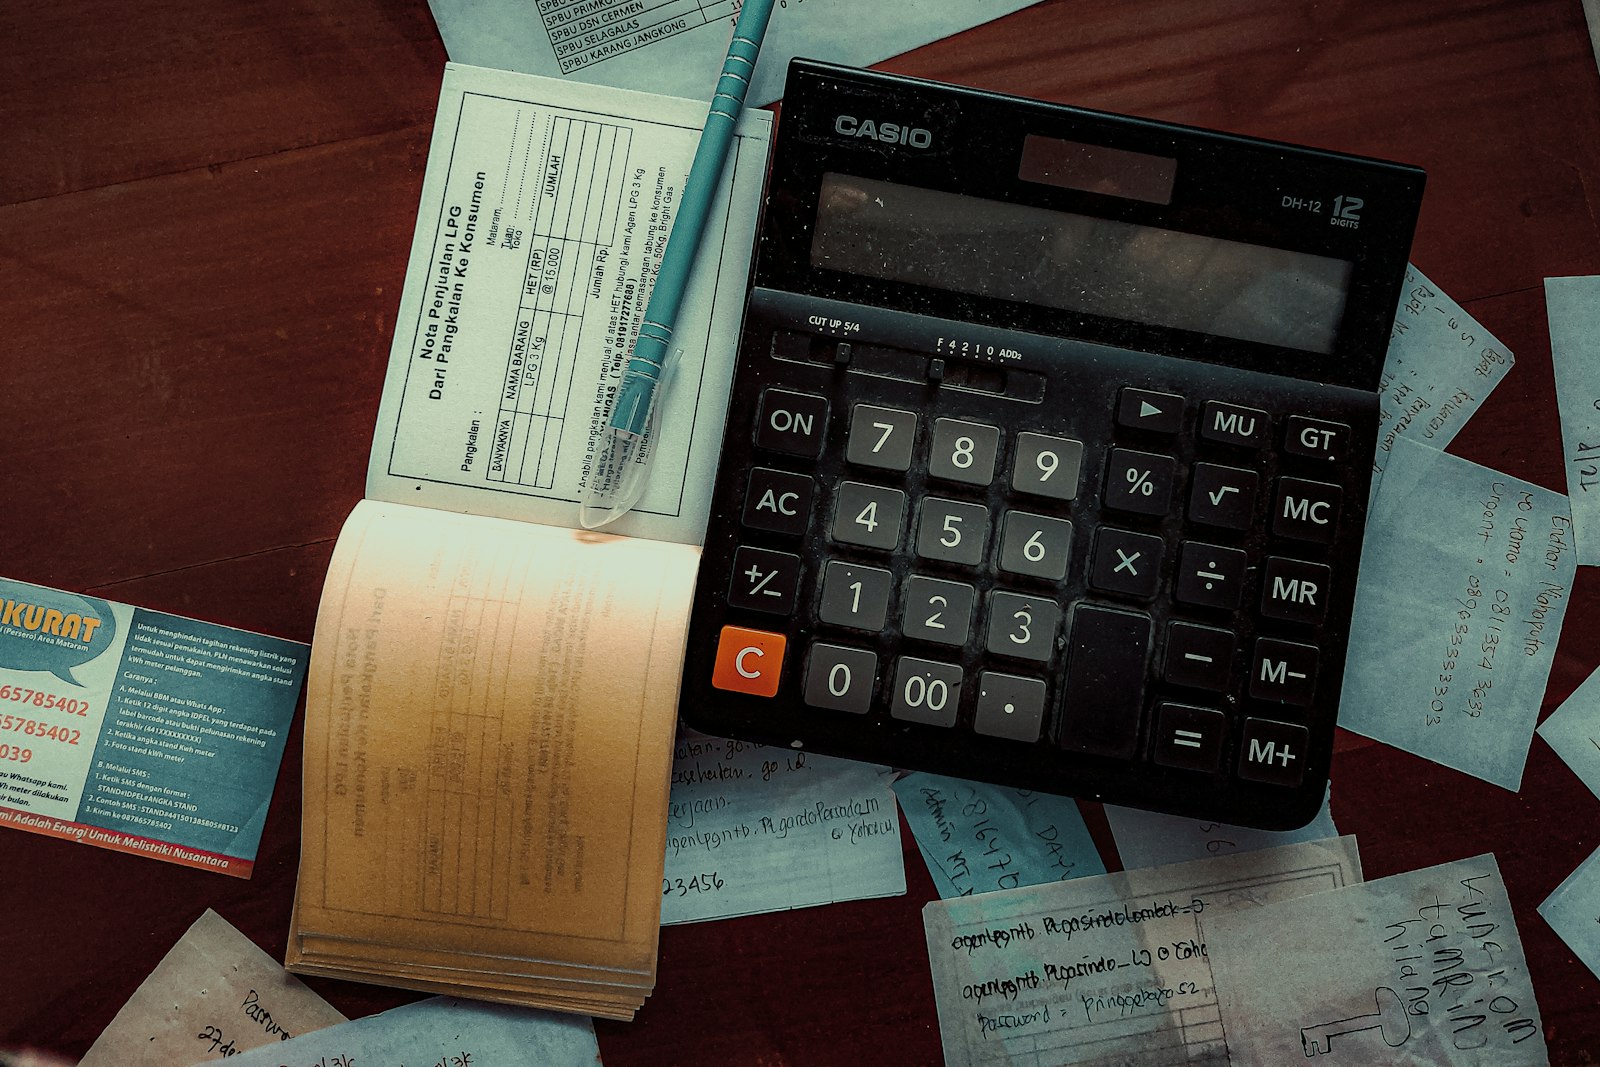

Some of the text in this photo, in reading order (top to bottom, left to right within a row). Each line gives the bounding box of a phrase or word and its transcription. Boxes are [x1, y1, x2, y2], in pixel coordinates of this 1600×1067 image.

[546, 12, 572, 26] SPBU
[551, 2, 644, 41] SPBU DSN CERMEN
[557, 20, 640, 56] SPBU SELAGALAS
[563, 19, 686, 71] SPBU KARANG JANGKONG
[835, 115, 932, 149] CASIO
[633, 168, 645, 180] Kg
[650, 166, 665, 210] konsumen
[628, 190, 639, 208] LPG
[663, 186, 673, 203] Gas
[1281, 195, 1322, 213] DH-12
[1333, 195, 1364, 220] 12
[624, 211, 635, 233] Agen
[648, 212, 657, 222] ke
[658, 205, 670, 231] Bright
[1330, 217, 1359, 229] DIGITS
[509, 229, 522, 249] Toko
[619, 235, 631, 255] kami
[643, 225, 657, 253] tabung
[420, 206, 461, 358] Nota Penjualan LPG
[428, 172, 484, 399] Dari Pangkalan Ke Konsumen
[590, 247, 609, 298] Jumlah Rp.
[614, 257, 629, 292] hubungi
[635, 256, 650, 311] pemasangan
[492, 155, 560, 471] BANYAKNYA NAMA BARANG HET (RP) JUMLAH
[524, 363, 537, 386] LPG
[531, 336, 545, 350] Kg
[544, 247, 559, 280] 15.000
[610, 293, 620, 313] HET
[615, 284, 634, 347] 081917277688
[607, 315, 617, 334] atas
[630, 313, 640, 336] antar
[808, 316, 860, 333] CUT UP 5/4
[604, 336, 613, 344] di
[937, 337, 944, 347] F
[949, 339, 957, 349] 4
[962, 341, 969, 351] 2
[975, 344, 980, 353] 1
[987, 346, 994, 356] 0
[599, 346, 611, 380] menjual
[610, 351, 623, 371] Telp.
[593, 382, 605, 403] kami
[587, 406, 600, 452] pangkalan
[1214, 411, 1335, 451] MU GT
[460, 420, 479, 471] Pangkalan
[770, 409, 813, 436] ON
[872, 422, 894, 453] 7
[951, 437, 975, 468] 8
[1036, 450, 1059, 482] 9
[1283, 496, 1330, 525] MC
[755, 489, 1046, 562] AC 4 5 6
[1272, 576, 1317, 605] MR
[0, 598, 101, 643] KURAT
[850, 581, 862, 613] 1
[925, 595, 947, 629] 2
[1009, 611, 1032, 644] 3
[38, 634, 55, 645] Area
[55, 640, 89, 652] Mataram
[735, 646, 948, 711] C 0 00
[0, 714, 80, 745] 5785402
[1249, 738, 1295, 767] M+
[12, 813, 51, 829] Adalah
[52, 821, 88, 838] Energi
[88, 829, 121, 844] Untuk
[122, 837, 172, 854] Melistriki
[172, 848, 228, 867] Nusantara
